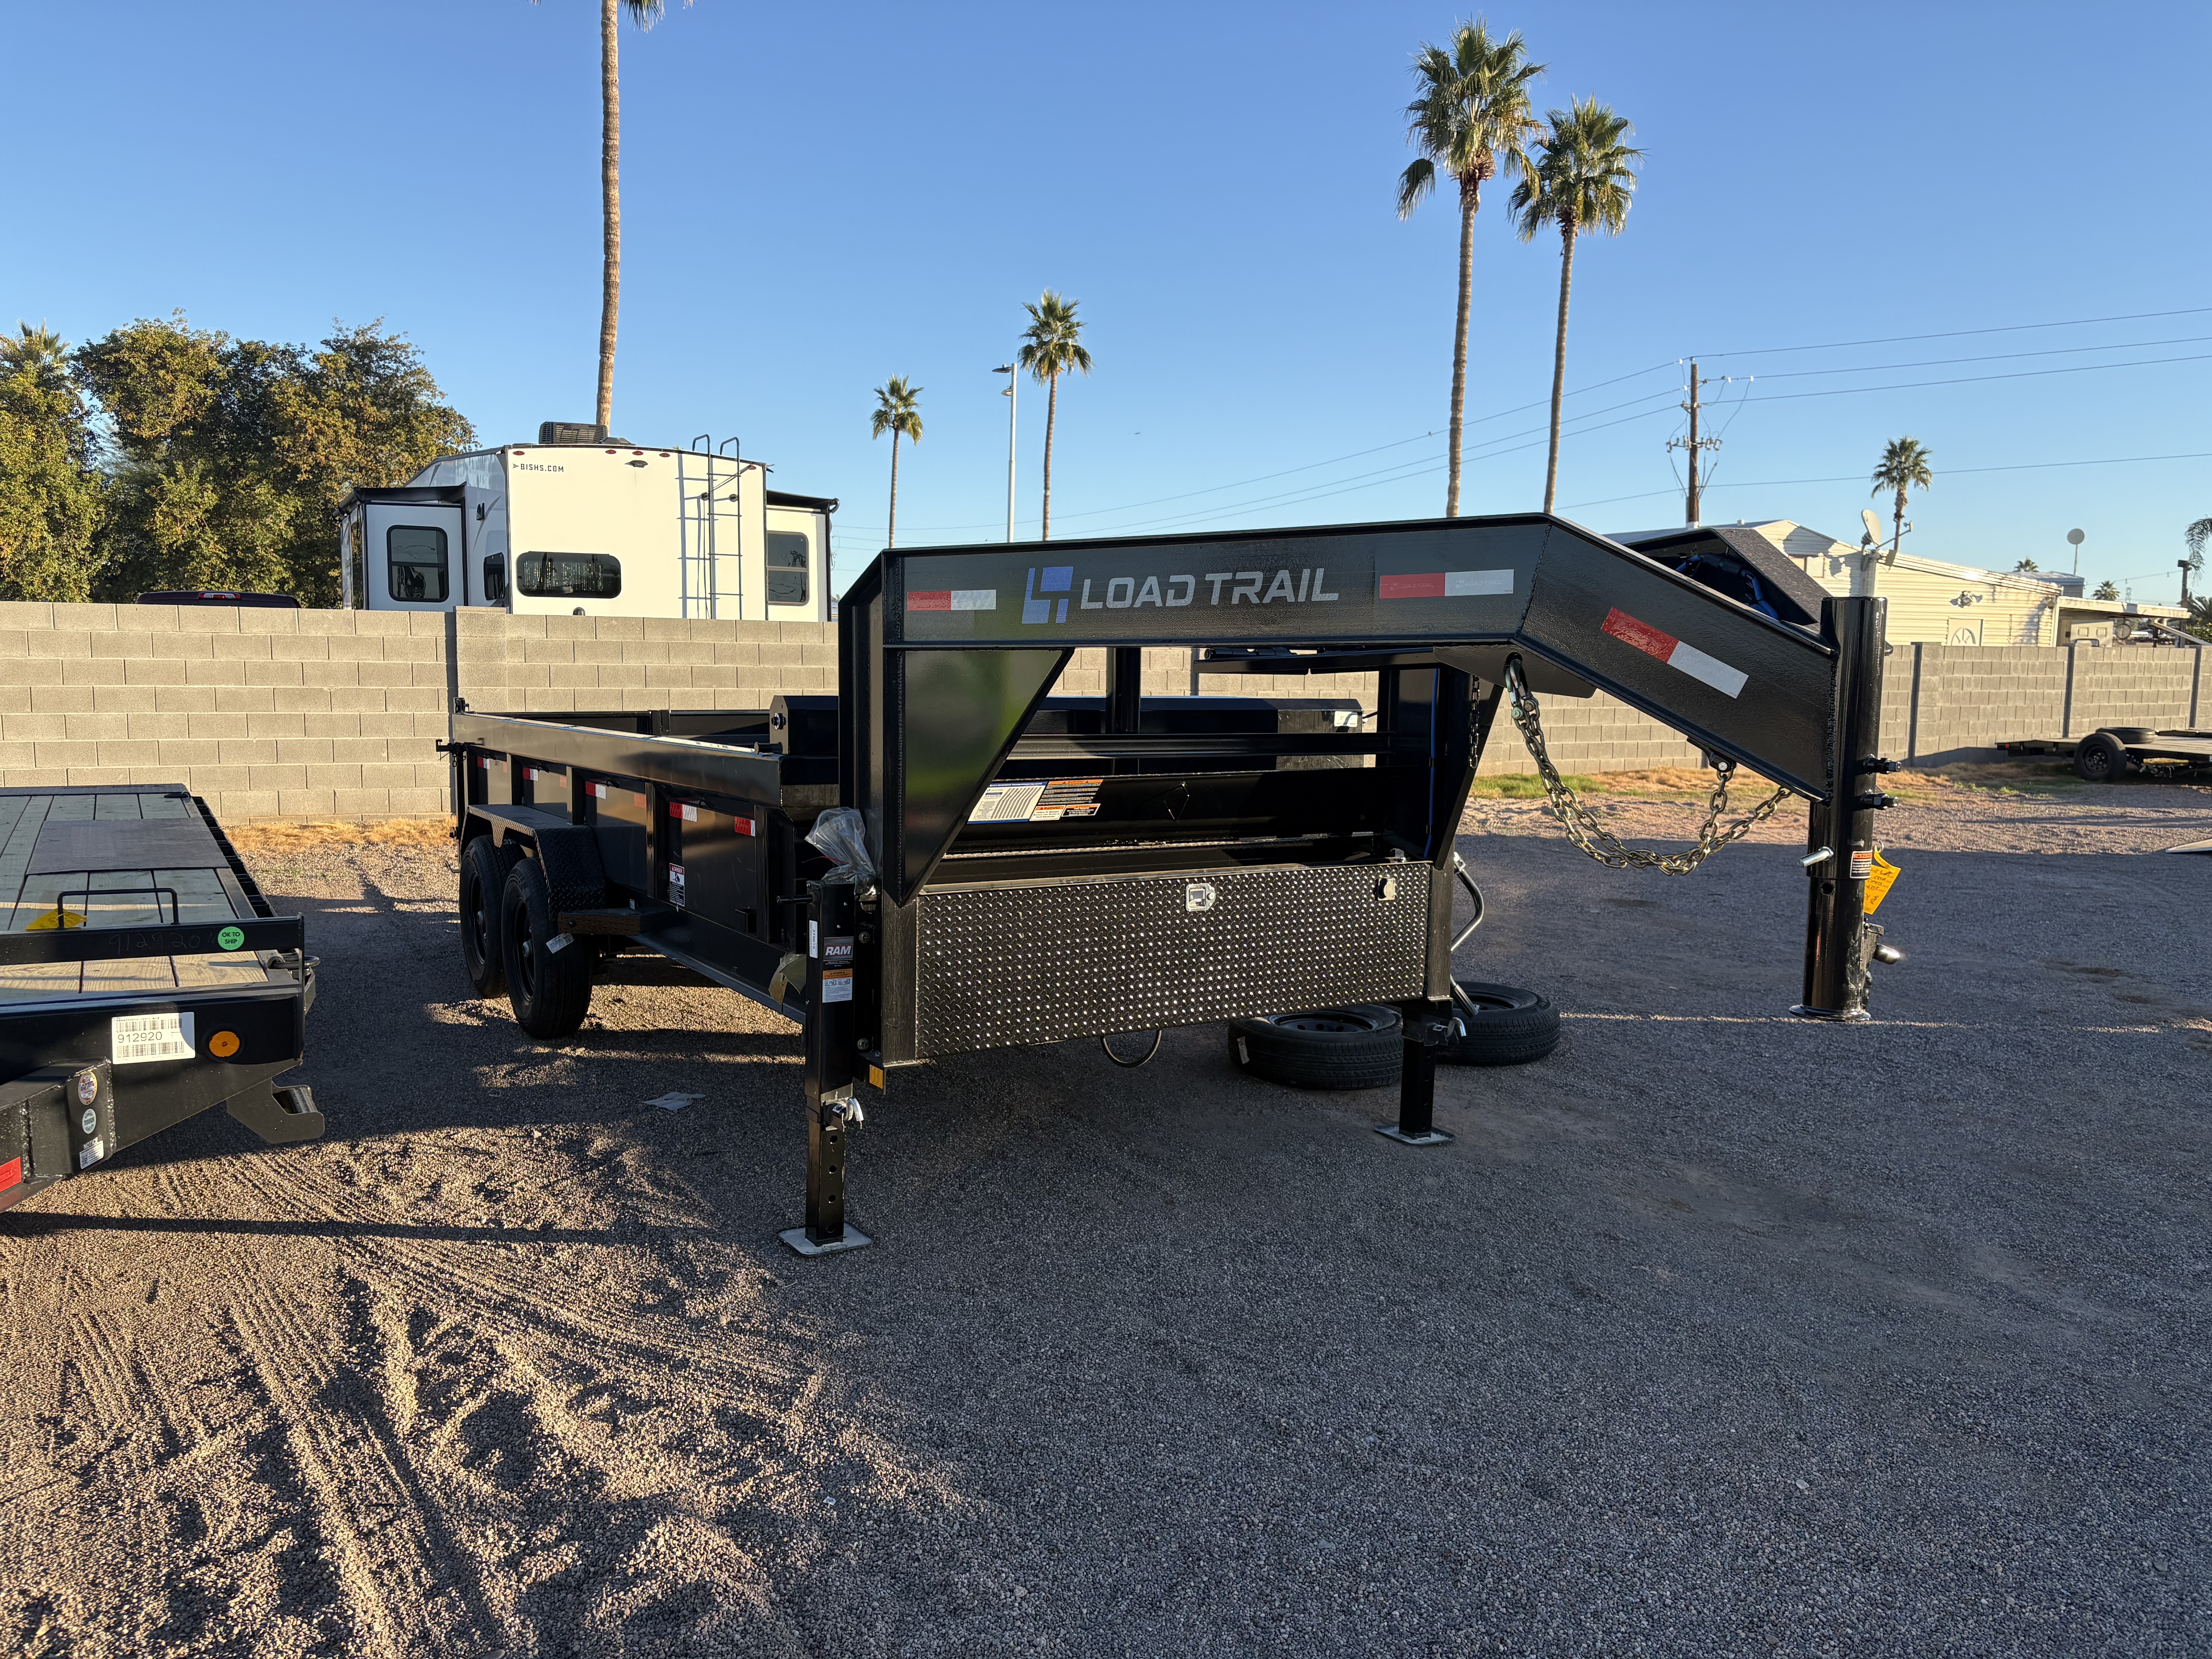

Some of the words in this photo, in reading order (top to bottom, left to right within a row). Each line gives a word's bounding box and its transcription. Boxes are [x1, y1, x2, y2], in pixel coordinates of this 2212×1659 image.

[520, 463, 564, 472] BISHS.COM
[1080, 574, 1195, 609] LOAD
[1205, 568, 1340, 605] TRAIL
[825, 945, 852, 956] RAM
[117, 1031, 162, 1043] 912920
[83, 1137, 98, 1149] NOTICE
